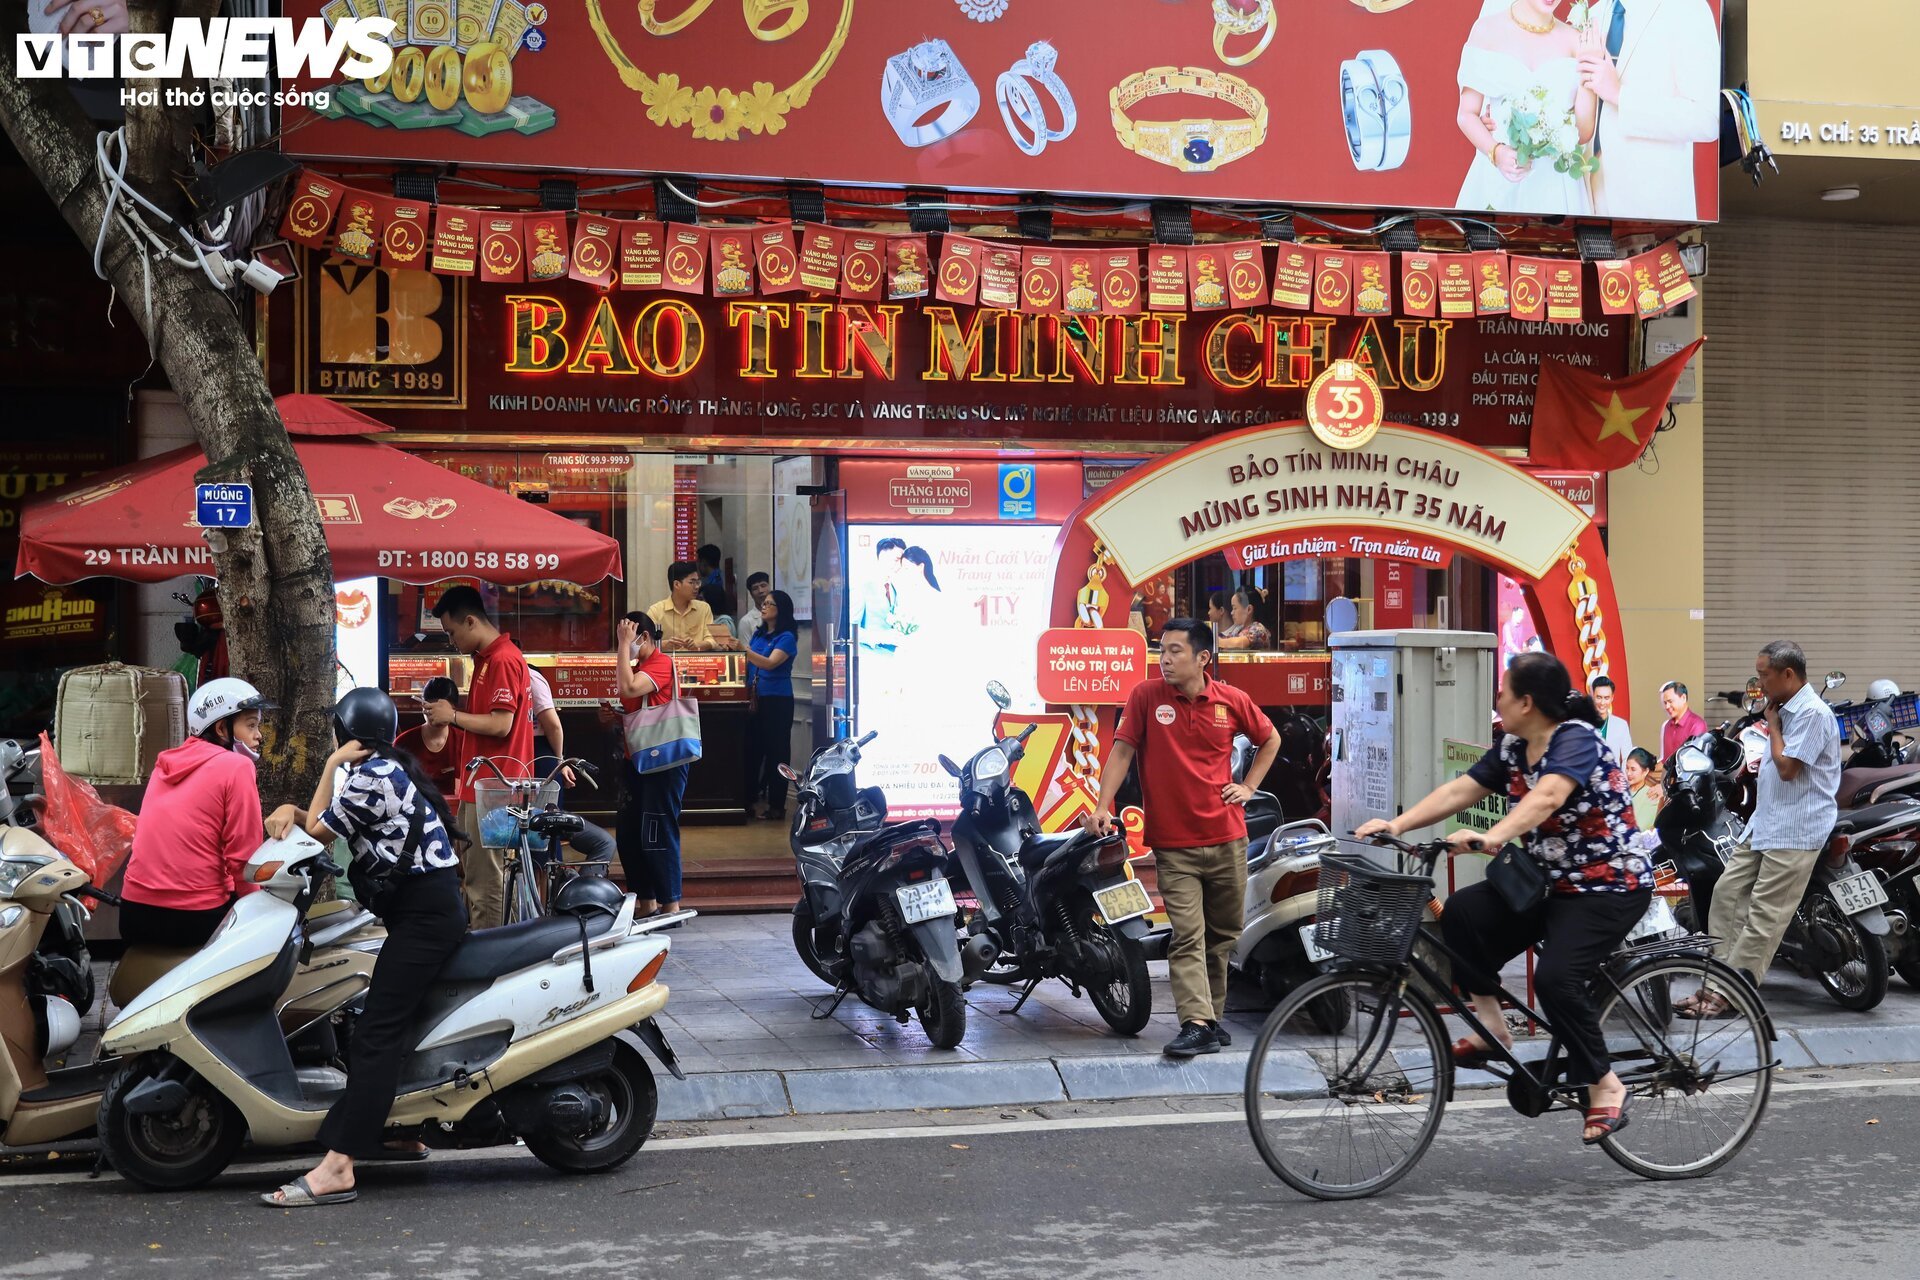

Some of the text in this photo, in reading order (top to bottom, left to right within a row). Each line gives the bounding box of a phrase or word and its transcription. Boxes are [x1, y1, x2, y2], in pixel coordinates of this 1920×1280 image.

[426, 16, 438, 25] 10
[1782, 122, 1812, 144] ĐỊA
[1820, 120, 1854, 142] CHỈ:
[1860, 126, 1879, 143] 35
[922, 306, 1186, 386] MINH
[1484, 351, 1499, 364] LÀ
[1502, 348, 1526, 365] CỬA
[320, 370, 443, 390] BTMC 1989
[1327, 387, 1364, 420] 35
[1472, 390, 1497, 405] PHỐ
[489, 395, 527, 410] KINH
[532, 396, 590, 412] DOANH
[646, 394, 692, 415] RỒNG
[699, 396, 752, 416] THĂNG
[844, 400, 864, 418] VÀ
[871, 401, 912, 419] VÀNG
[916, 404, 968, 420] TRANG
[971, 401, 1001, 421] SỨC
[1120, 405, 1152, 426] LIỆU
[1157, 403, 1198, 424] BẰNG
[1338, 421, 1352, 429] NĂM
[549, 456, 574, 465] TRANG
[575, 454, 590, 465] SỨC
[1229, 448, 1460, 487] BẢO TÍN MINH CHÂU
[909, 466, 952, 477] VÀNG RỒNG
[204, 486, 244, 500] MUỒNG
[892, 483, 969, 498] THĂNG LONG
[1567, 488, 1590, 501] BẢO
[216, 508, 237, 522] 17
[1180, 481, 1507, 542] MỪNG SINH NHẬT 35 NĂM
[84, 542, 214, 566] 29 TRẦN NH
[985, 549, 1019, 566] Cưới
[1023, 549, 1050, 565] Vàn
[1242, 535, 1441, 566] Giữ tín nhiệm Trọn niềm tin
[378, 550, 560, 570] ĐT: 1800 58 58 99
[1050, 644, 1134, 656] NGÀN QUÀ TRI ÂN
[1050, 655, 1134, 674] TỔNG TRỊ GIÁ
[558, 688, 589, 696] 09:00
[1063, 675, 1120, 692] LÊN ĐẾN
[1455, 749, 1469, 762] BẢO
[913, 762, 938, 774] 700
[1837, 876, 1872, 897] 30-Z1
[1845, 890, 1878, 911] 9567
[539, 997, 592, 1026] Spacy
